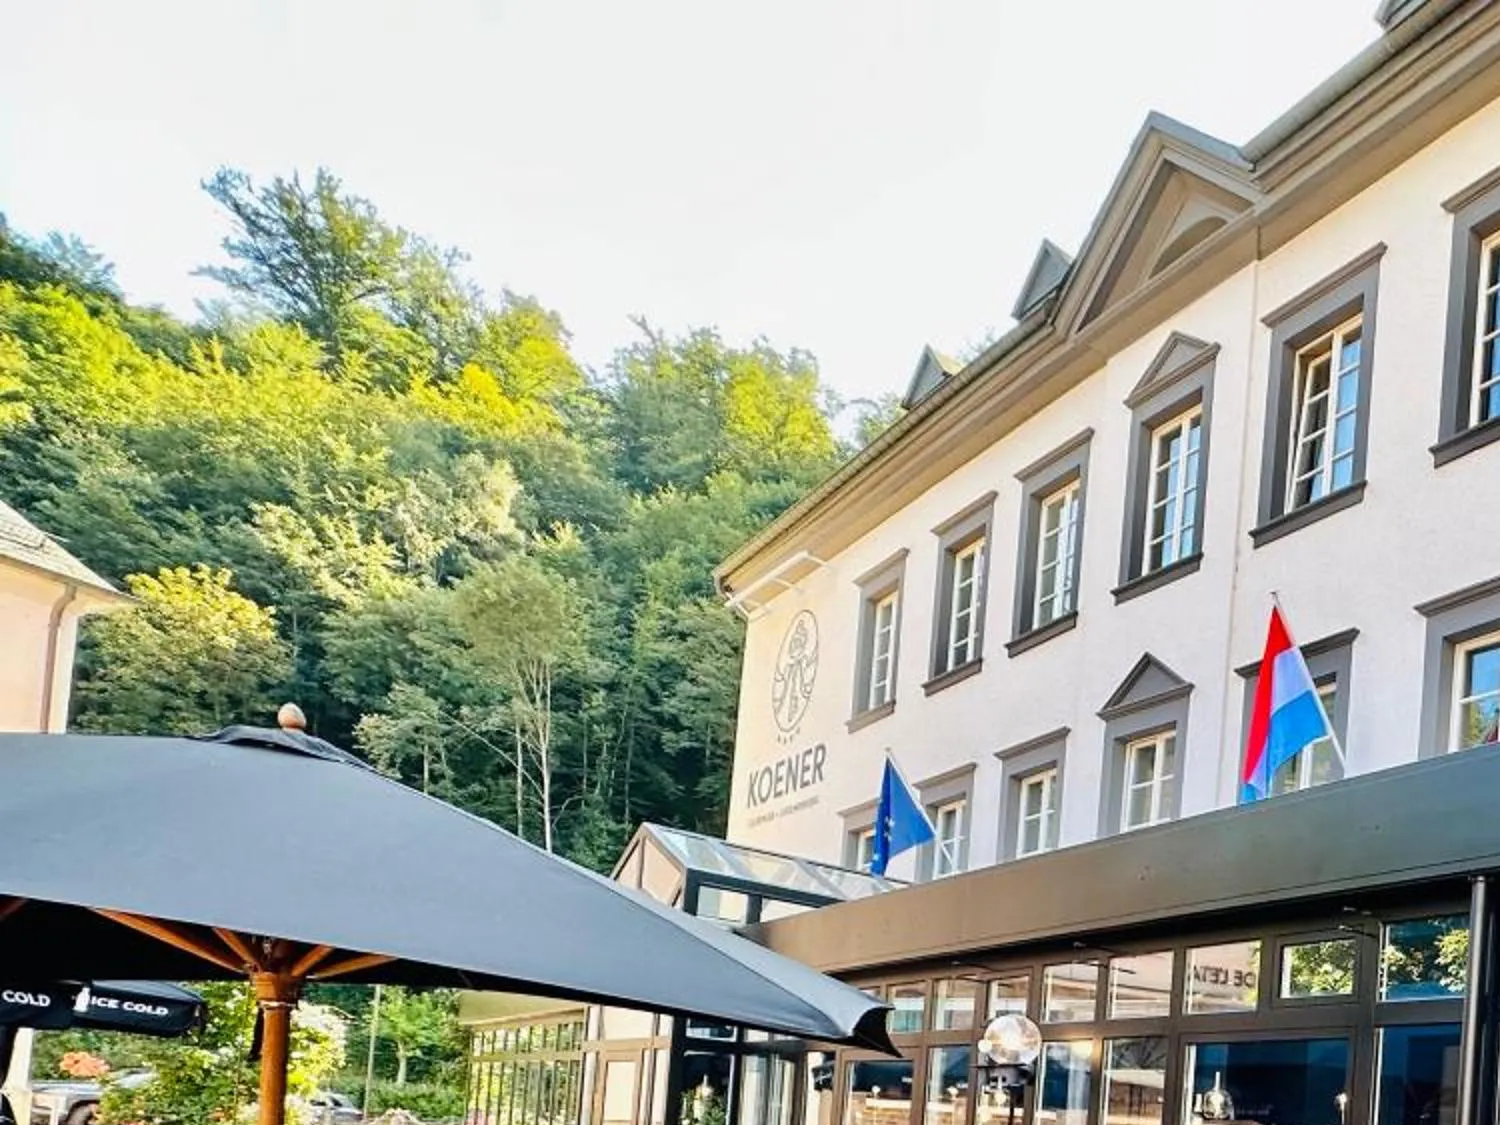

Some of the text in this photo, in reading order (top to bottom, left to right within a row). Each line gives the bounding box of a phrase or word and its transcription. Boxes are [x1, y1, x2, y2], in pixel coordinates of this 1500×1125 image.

[747, 743, 826, 808] KOENER
[2, 989, 51, 1007] COLD
[91, 996, 169, 1015] ICE COLD
